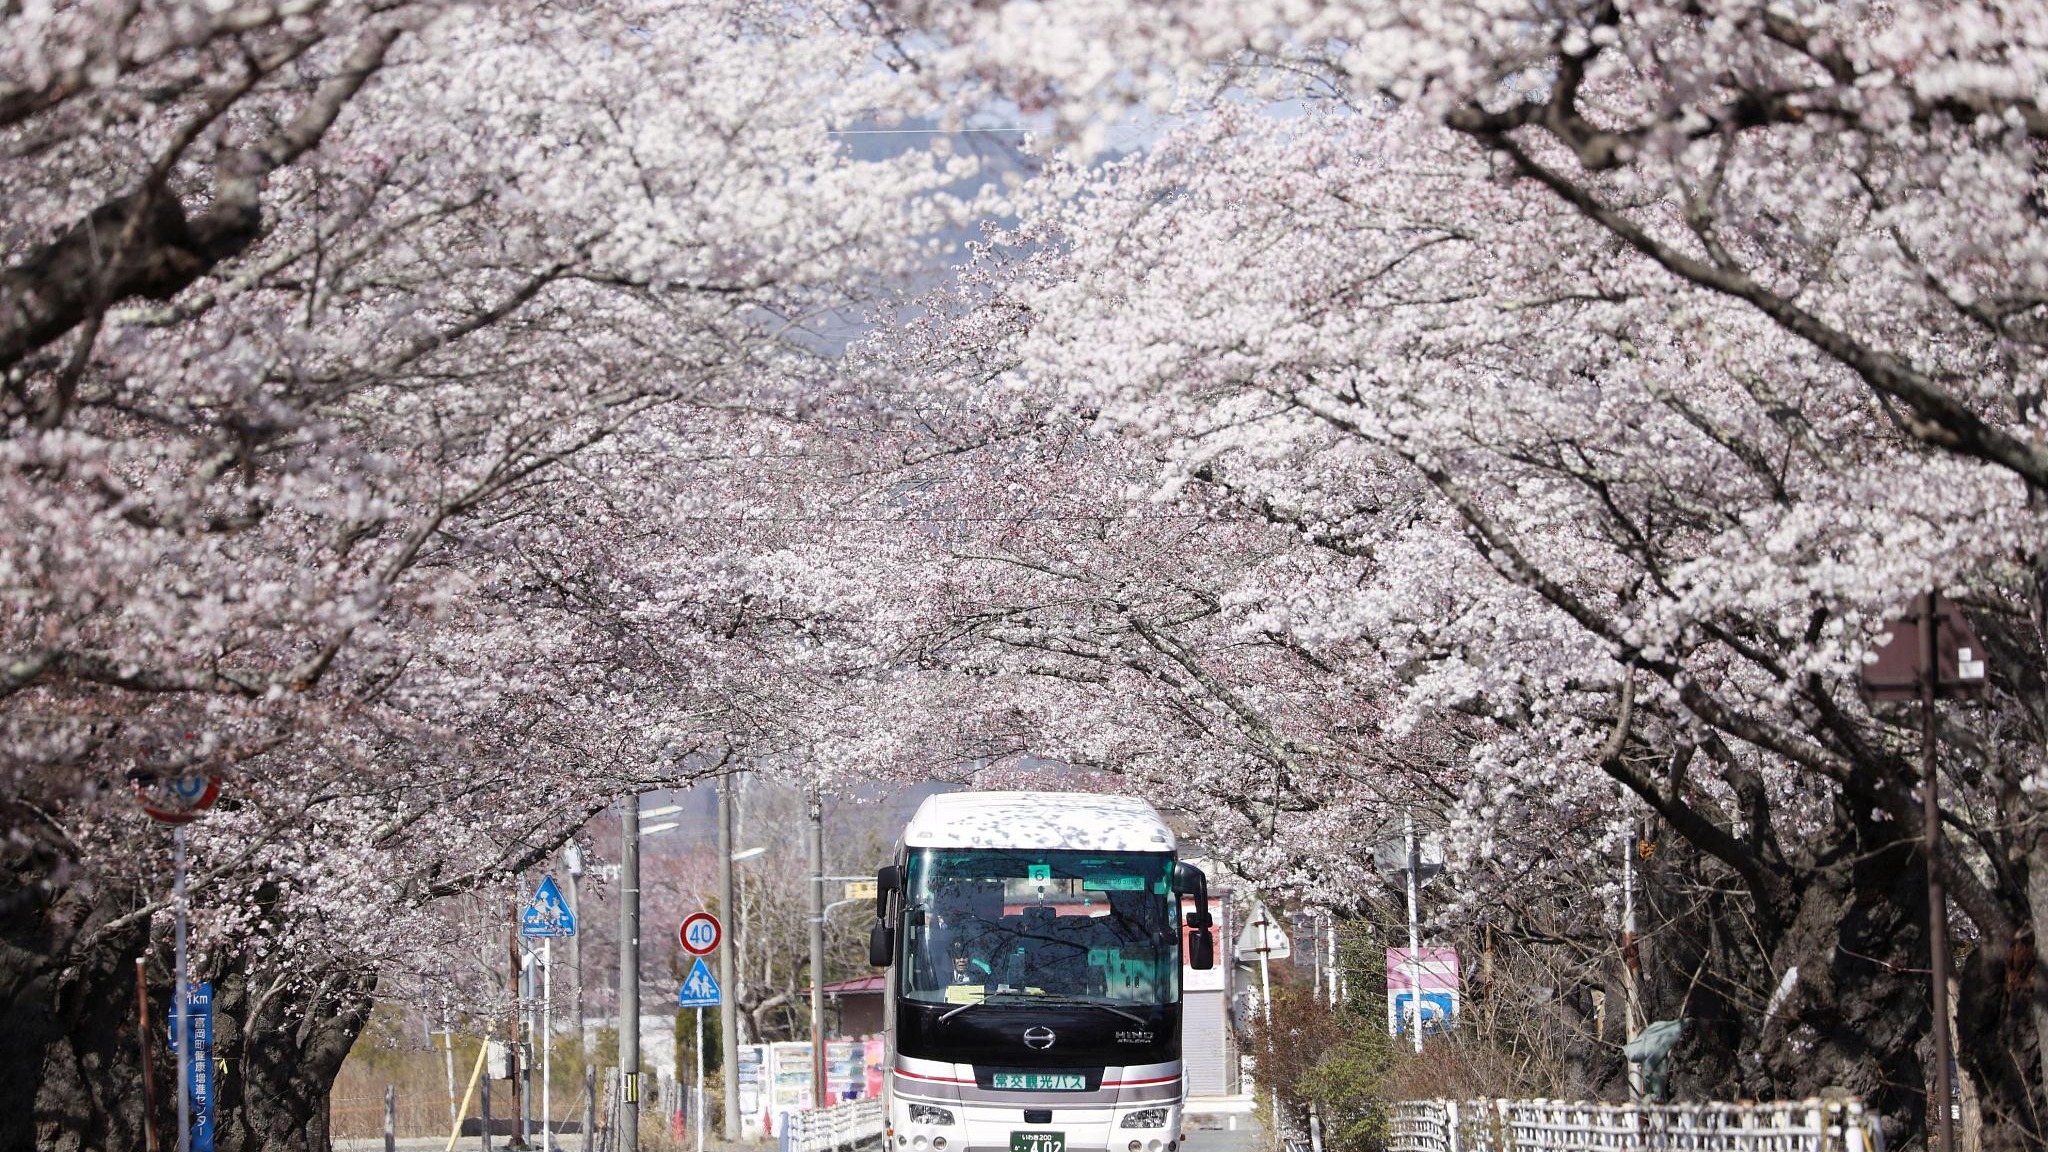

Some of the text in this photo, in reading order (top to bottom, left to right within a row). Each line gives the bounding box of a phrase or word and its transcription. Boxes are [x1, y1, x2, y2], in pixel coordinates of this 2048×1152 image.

[1035, 869, 1044, 881] 6
[690, 924, 712, 943] 40
[1115, 1031, 1154, 1039] HINO
[194, 1017, 207, 1136] 富岡町健康増進センター
[995, 1073, 1082, 1088] 常交観光バス
